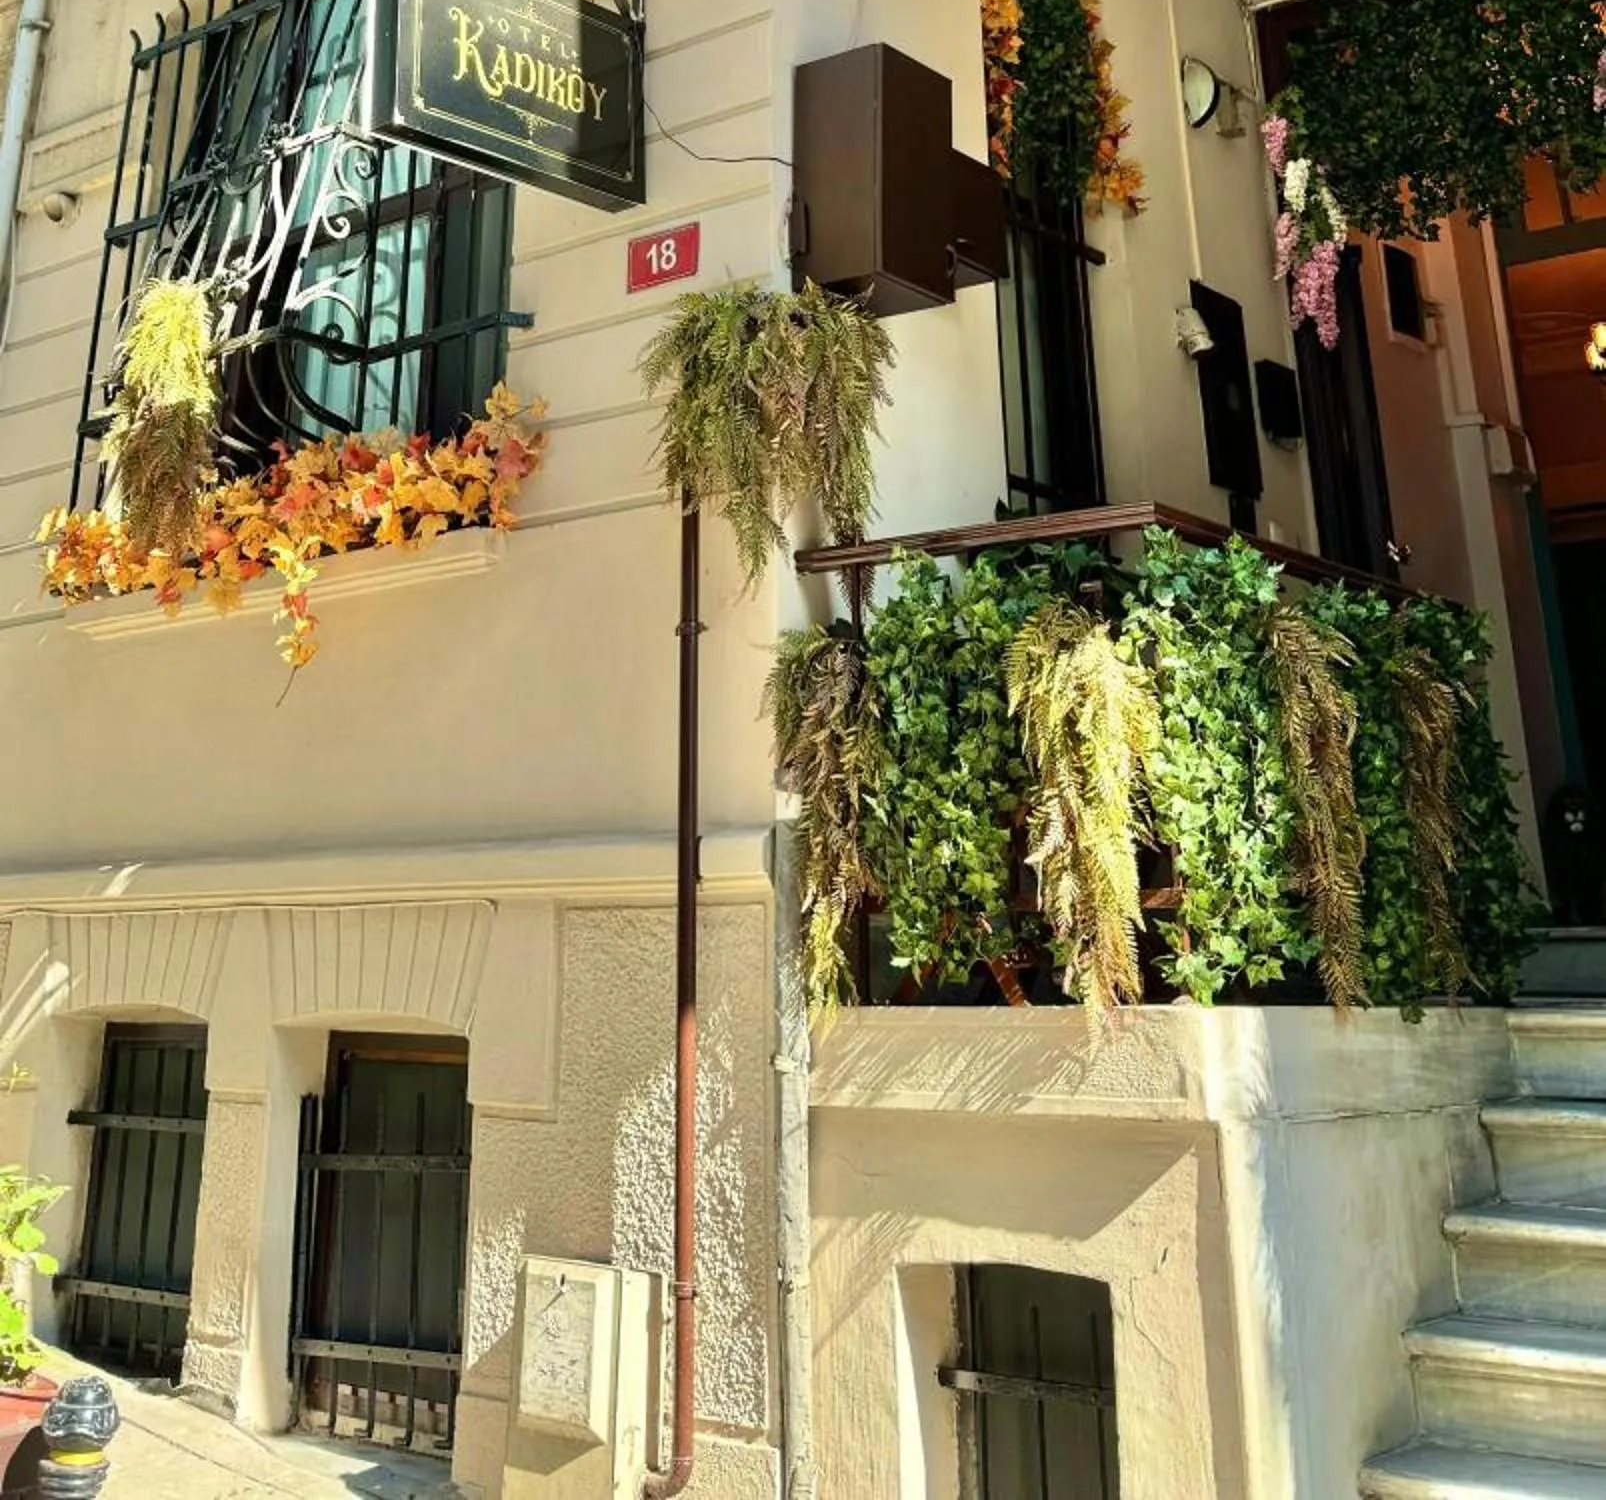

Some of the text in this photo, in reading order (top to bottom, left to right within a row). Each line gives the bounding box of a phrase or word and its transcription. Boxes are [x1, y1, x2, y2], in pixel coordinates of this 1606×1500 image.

[498, 17, 570, 59] OTEL
[448, 6, 608, 121] KADIKÖY
[646, 238, 677, 275] 18
